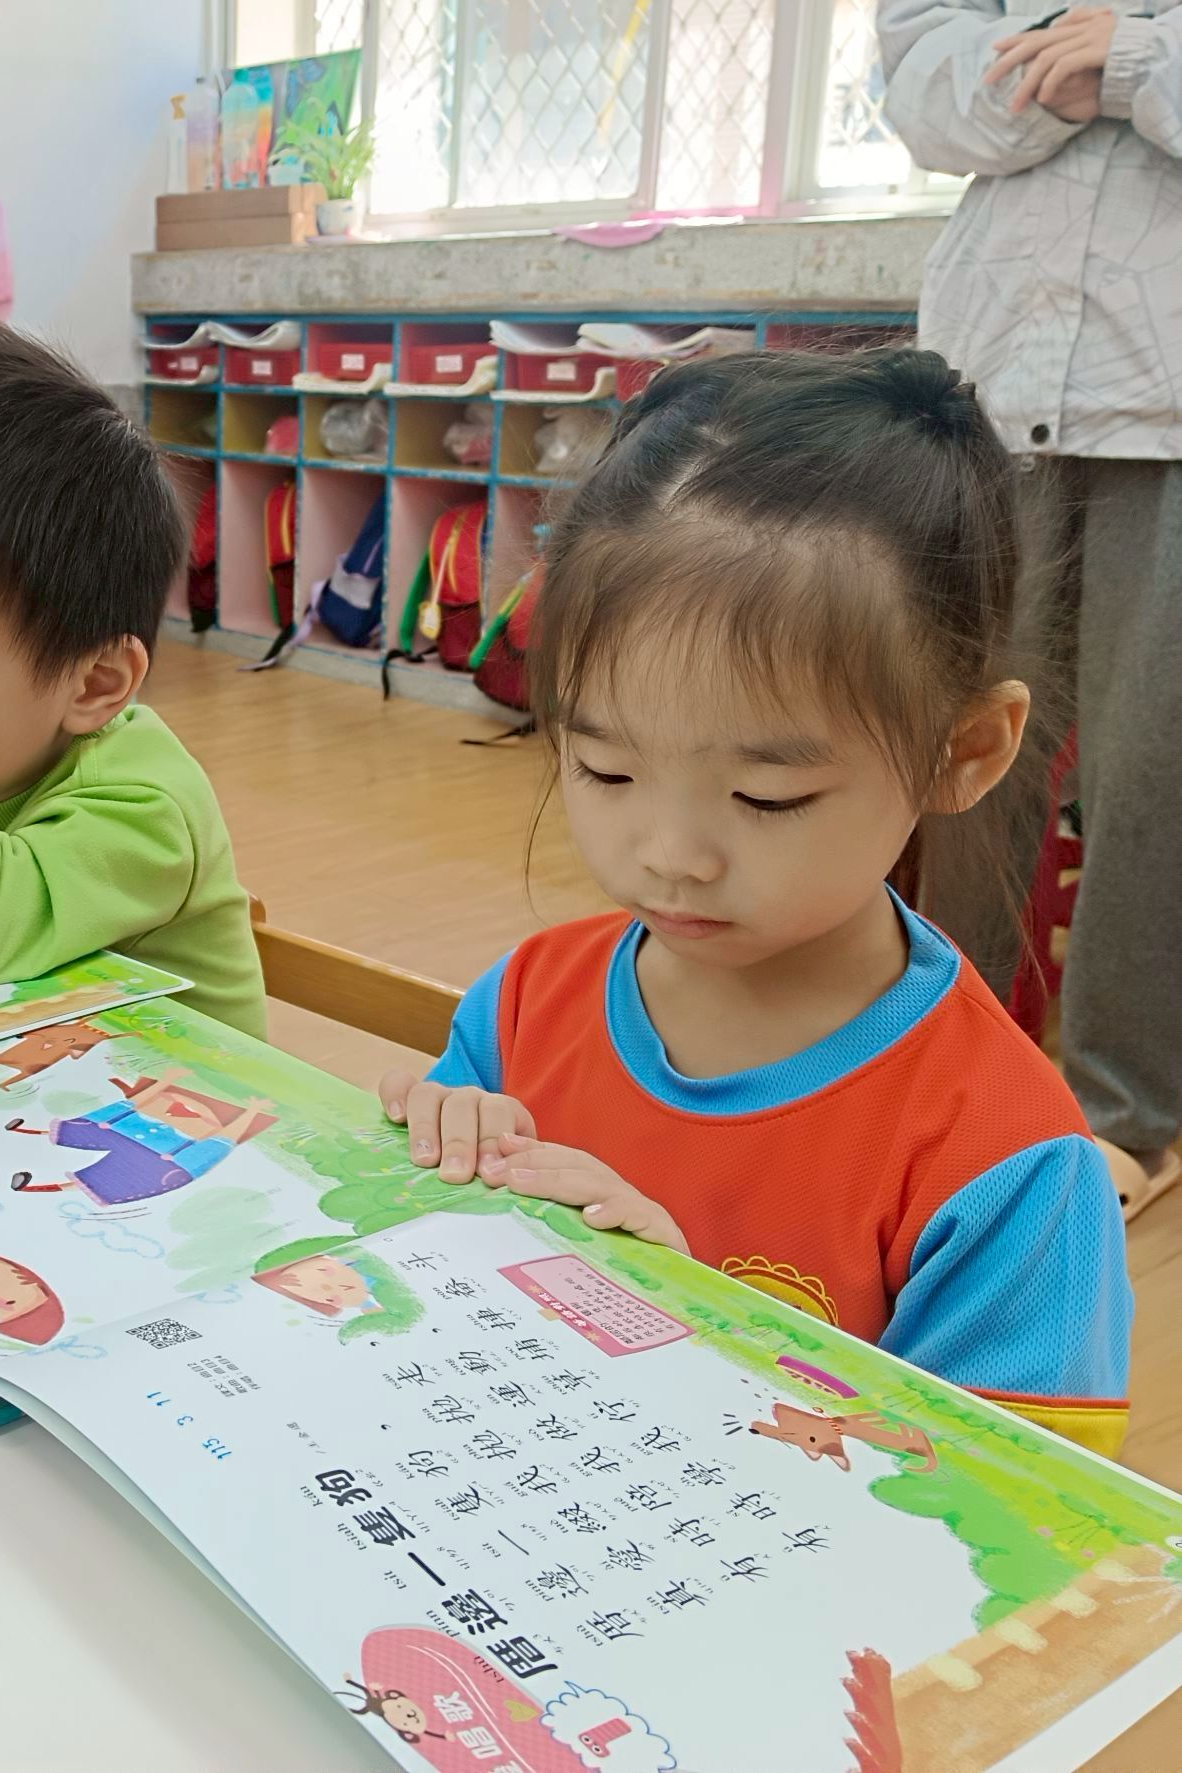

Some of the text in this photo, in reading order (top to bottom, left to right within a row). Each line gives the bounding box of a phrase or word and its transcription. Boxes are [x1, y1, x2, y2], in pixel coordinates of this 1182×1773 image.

[146, 1392, 234, 1460] 115 3 11
[338, 1522, 367, 1550] tsiah
[315, 1469, 558, 1679] 厝邊一隻狗
[426, 1608, 460, 1637] pinn
